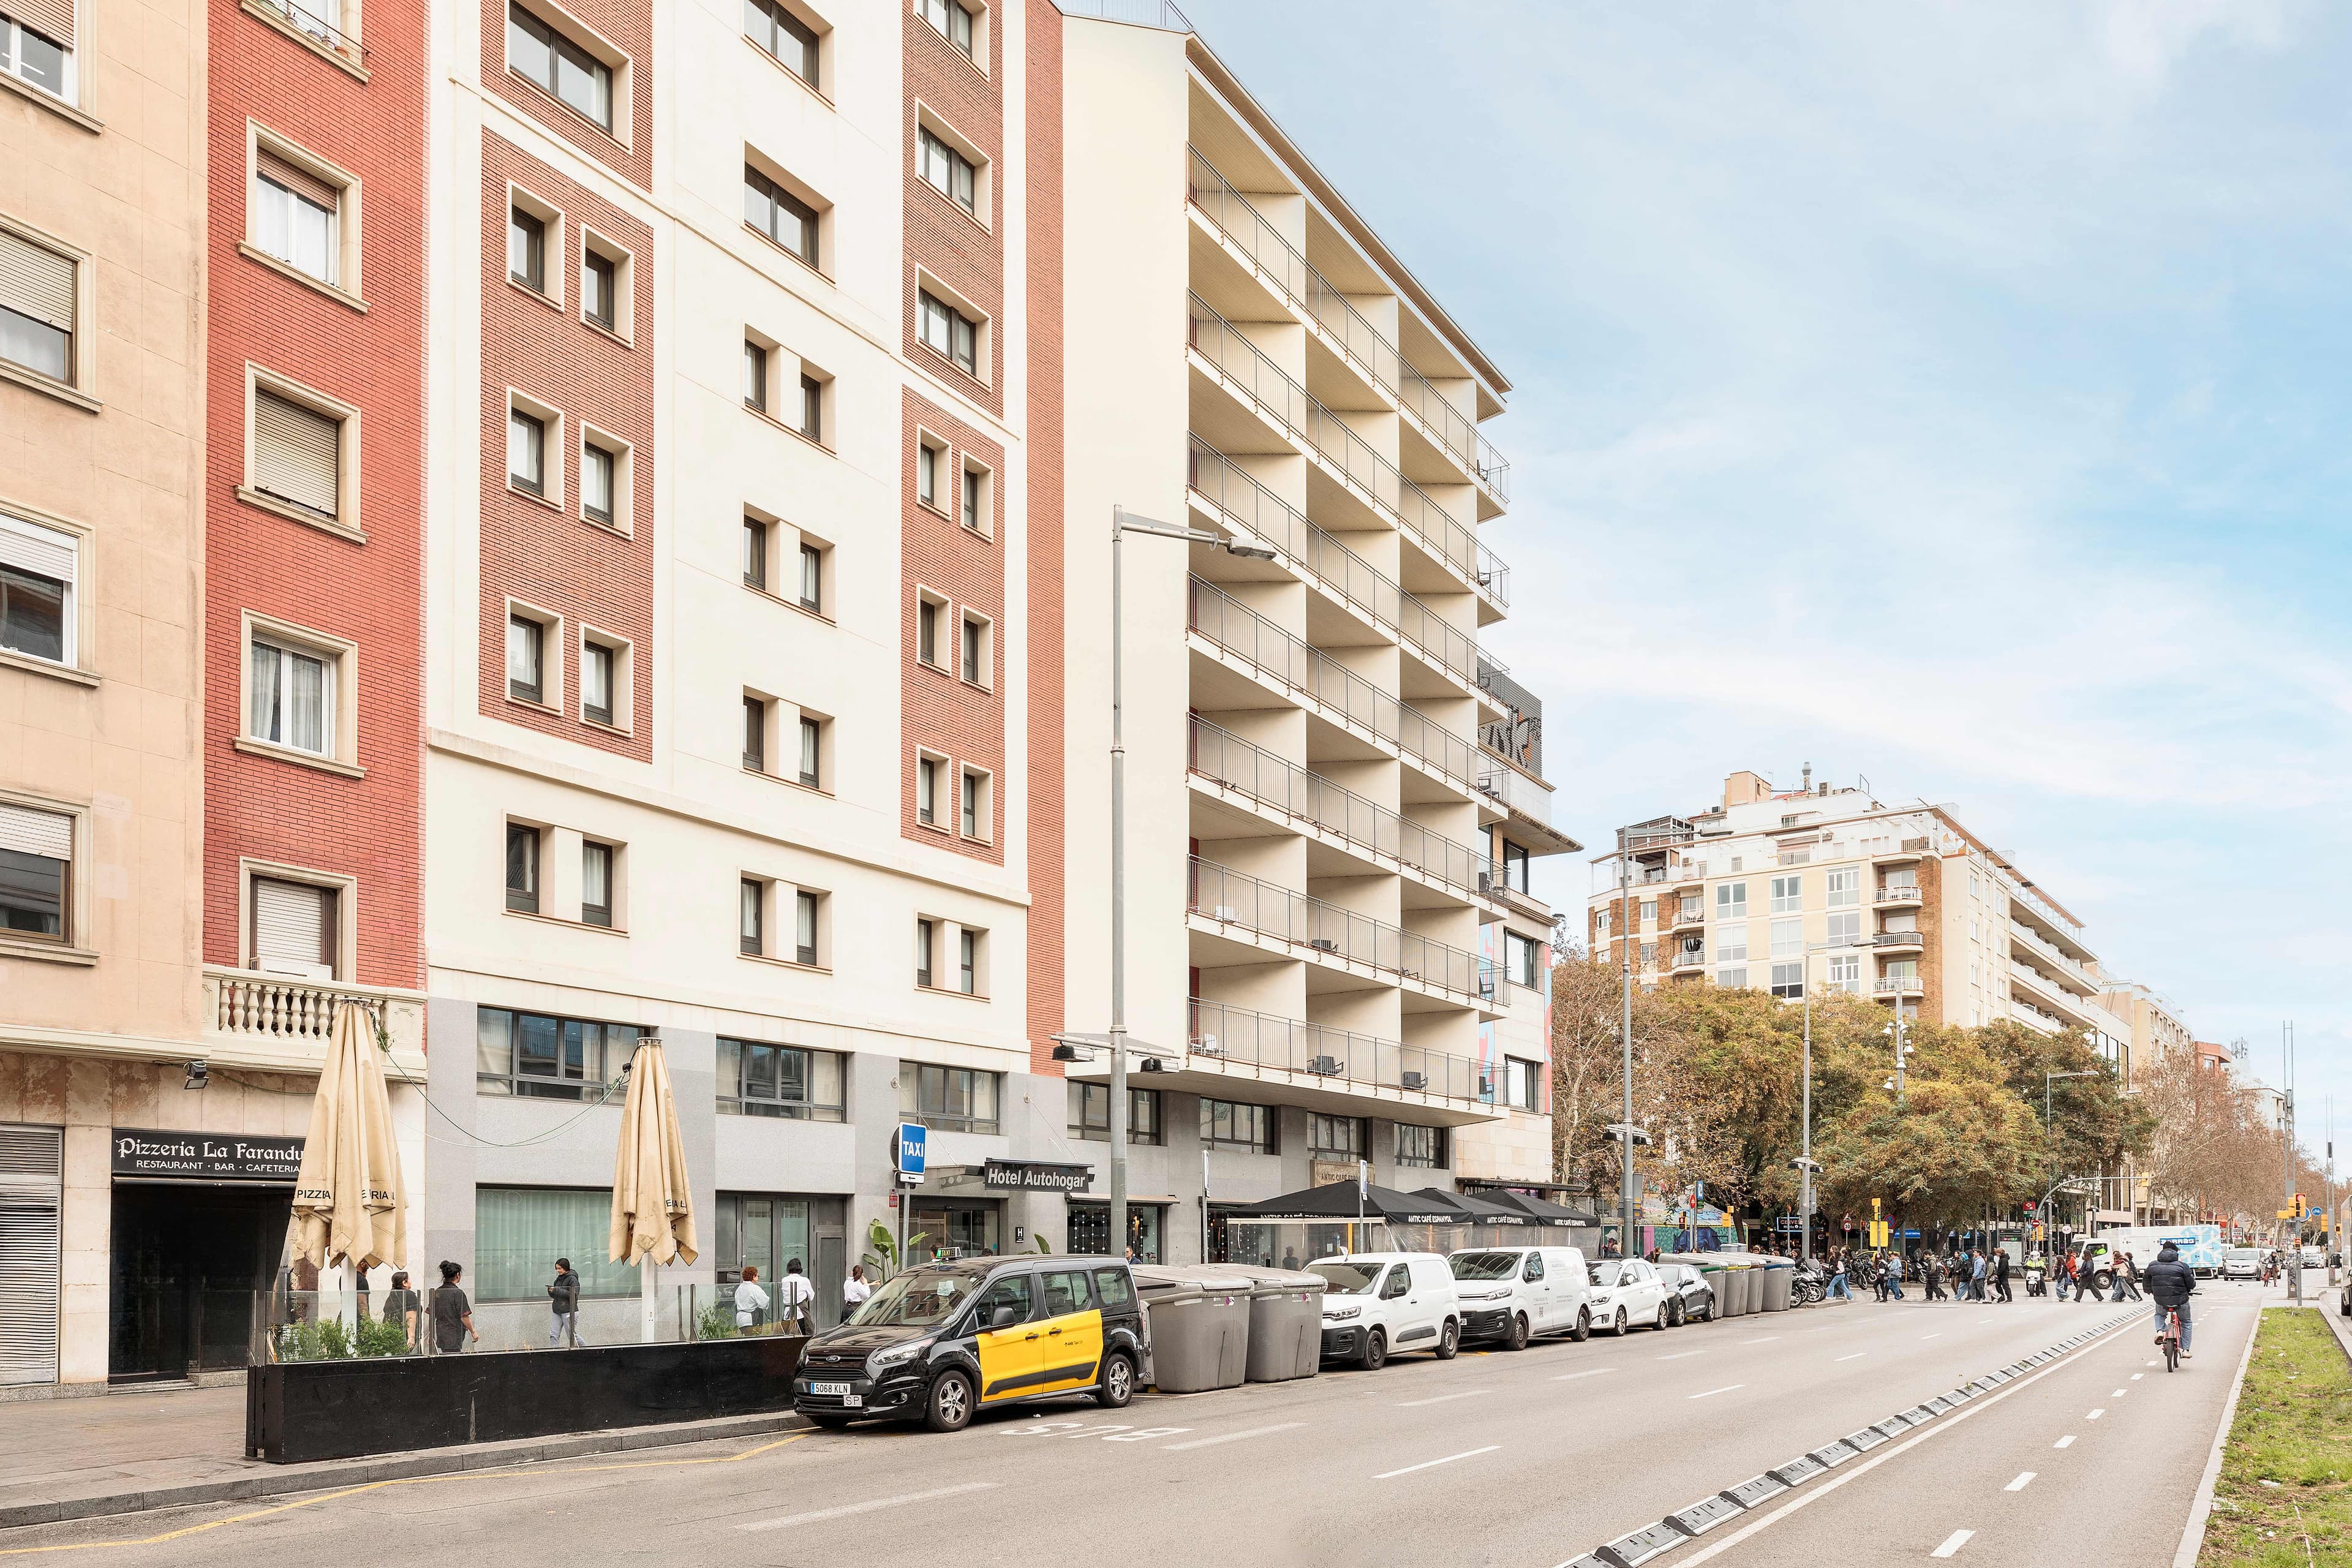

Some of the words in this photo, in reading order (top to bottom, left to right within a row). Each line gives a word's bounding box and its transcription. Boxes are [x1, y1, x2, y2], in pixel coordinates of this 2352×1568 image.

[116, 1137, 195, 1158] Pizzeria
[203, 1141, 228, 1158] La
[903, 1141, 924, 1157] TAXI
[136, 1161, 203, 1170] RESTAURANT
[214, 1163, 235, 1171] BAR
[246, 1164, 300, 1173] CAFETERIA
[988, 1169, 1022, 1185] Hotel
[1024, 1170, 1085, 1190] Autohogar
[1421, 1214, 1431, 1223] CAFÉ
[1018, 1228, 1022, 1237] H
[815, 1384, 832, 1393] 5068
[834, 1384, 848, 1393] KLN
[1000, 1423, 1196, 1441] BUS
